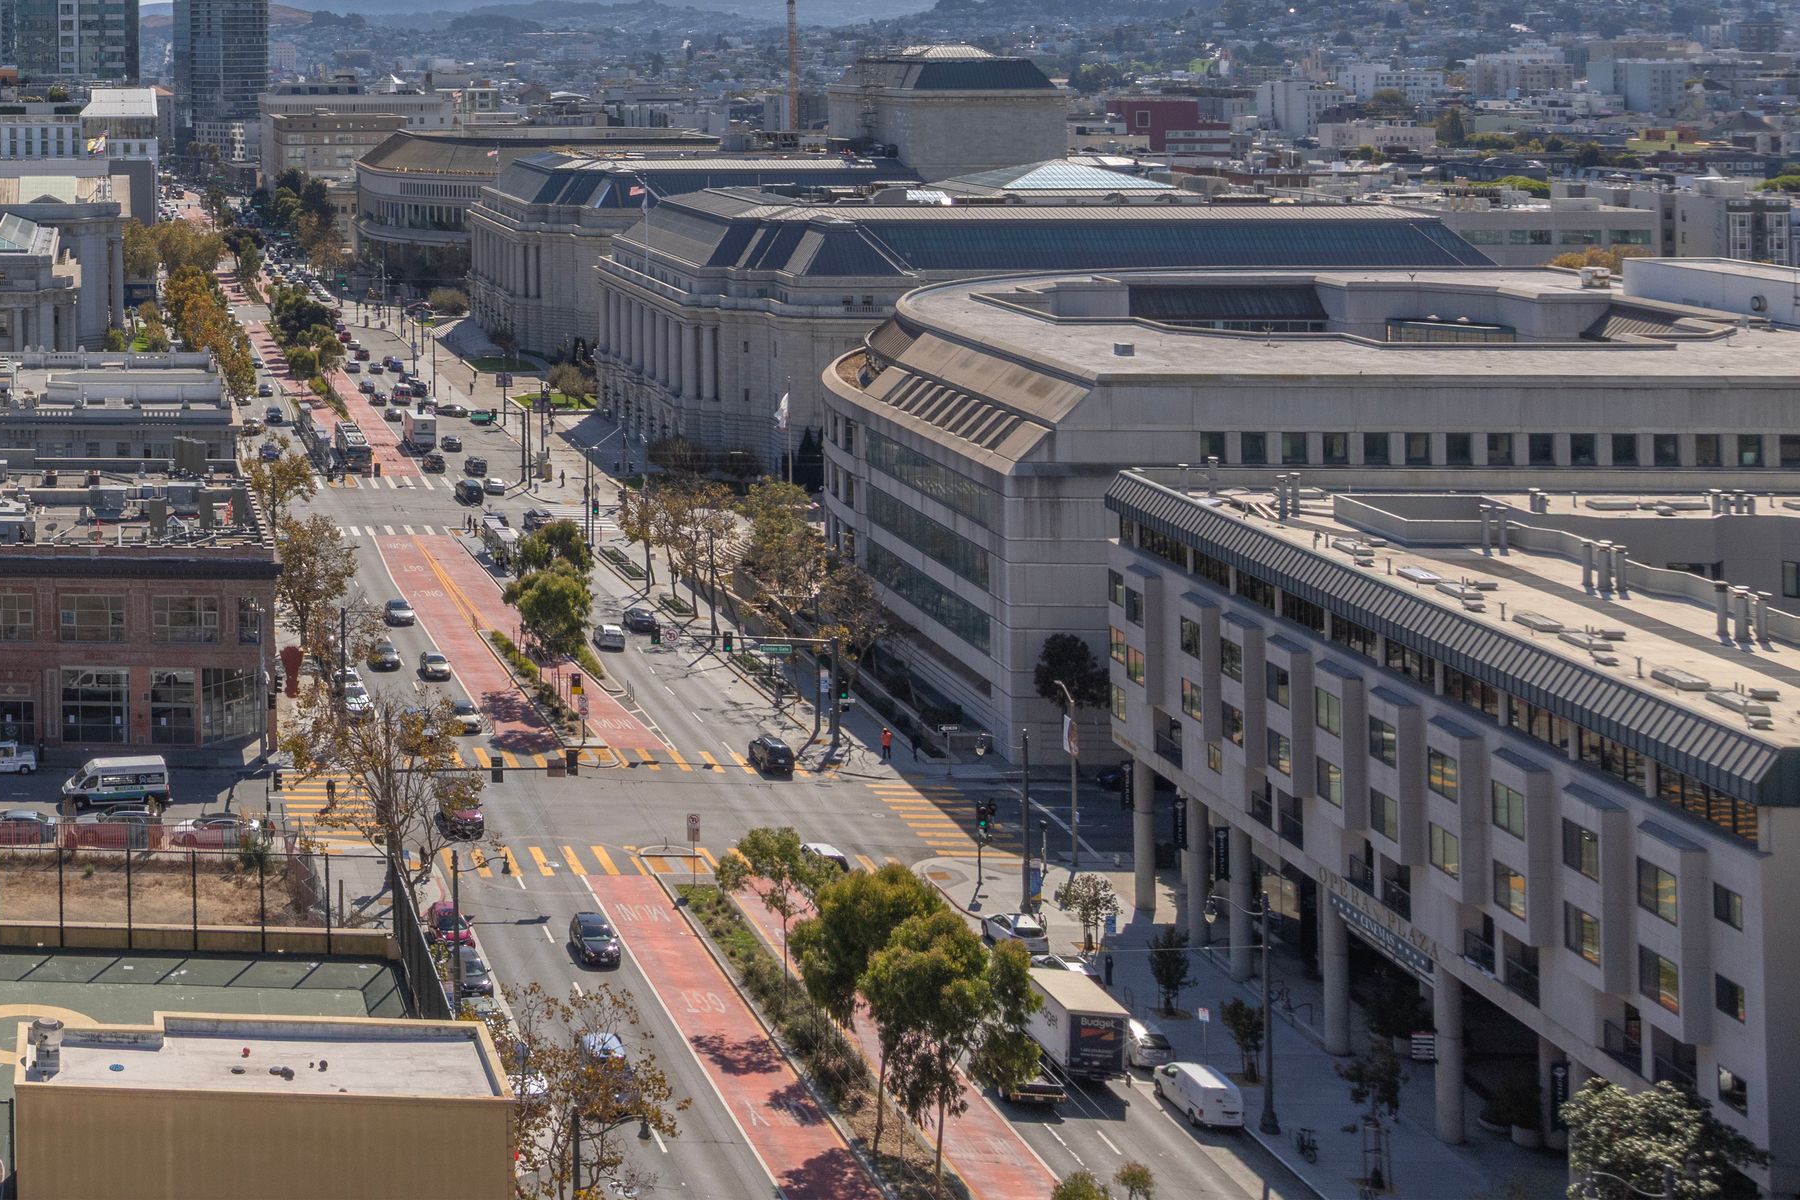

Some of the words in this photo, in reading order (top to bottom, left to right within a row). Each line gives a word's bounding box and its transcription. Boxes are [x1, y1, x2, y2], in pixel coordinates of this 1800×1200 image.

[615, 903, 672, 922] MUNI
[1319, 867, 1370, 915] OPERA
[1388, 910, 1439, 961] PLAZA
[1360, 914, 1395, 945] CINEMAS
[681, 991, 726, 1014] GGT
[1081, 1016, 1115, 1030] Budget
